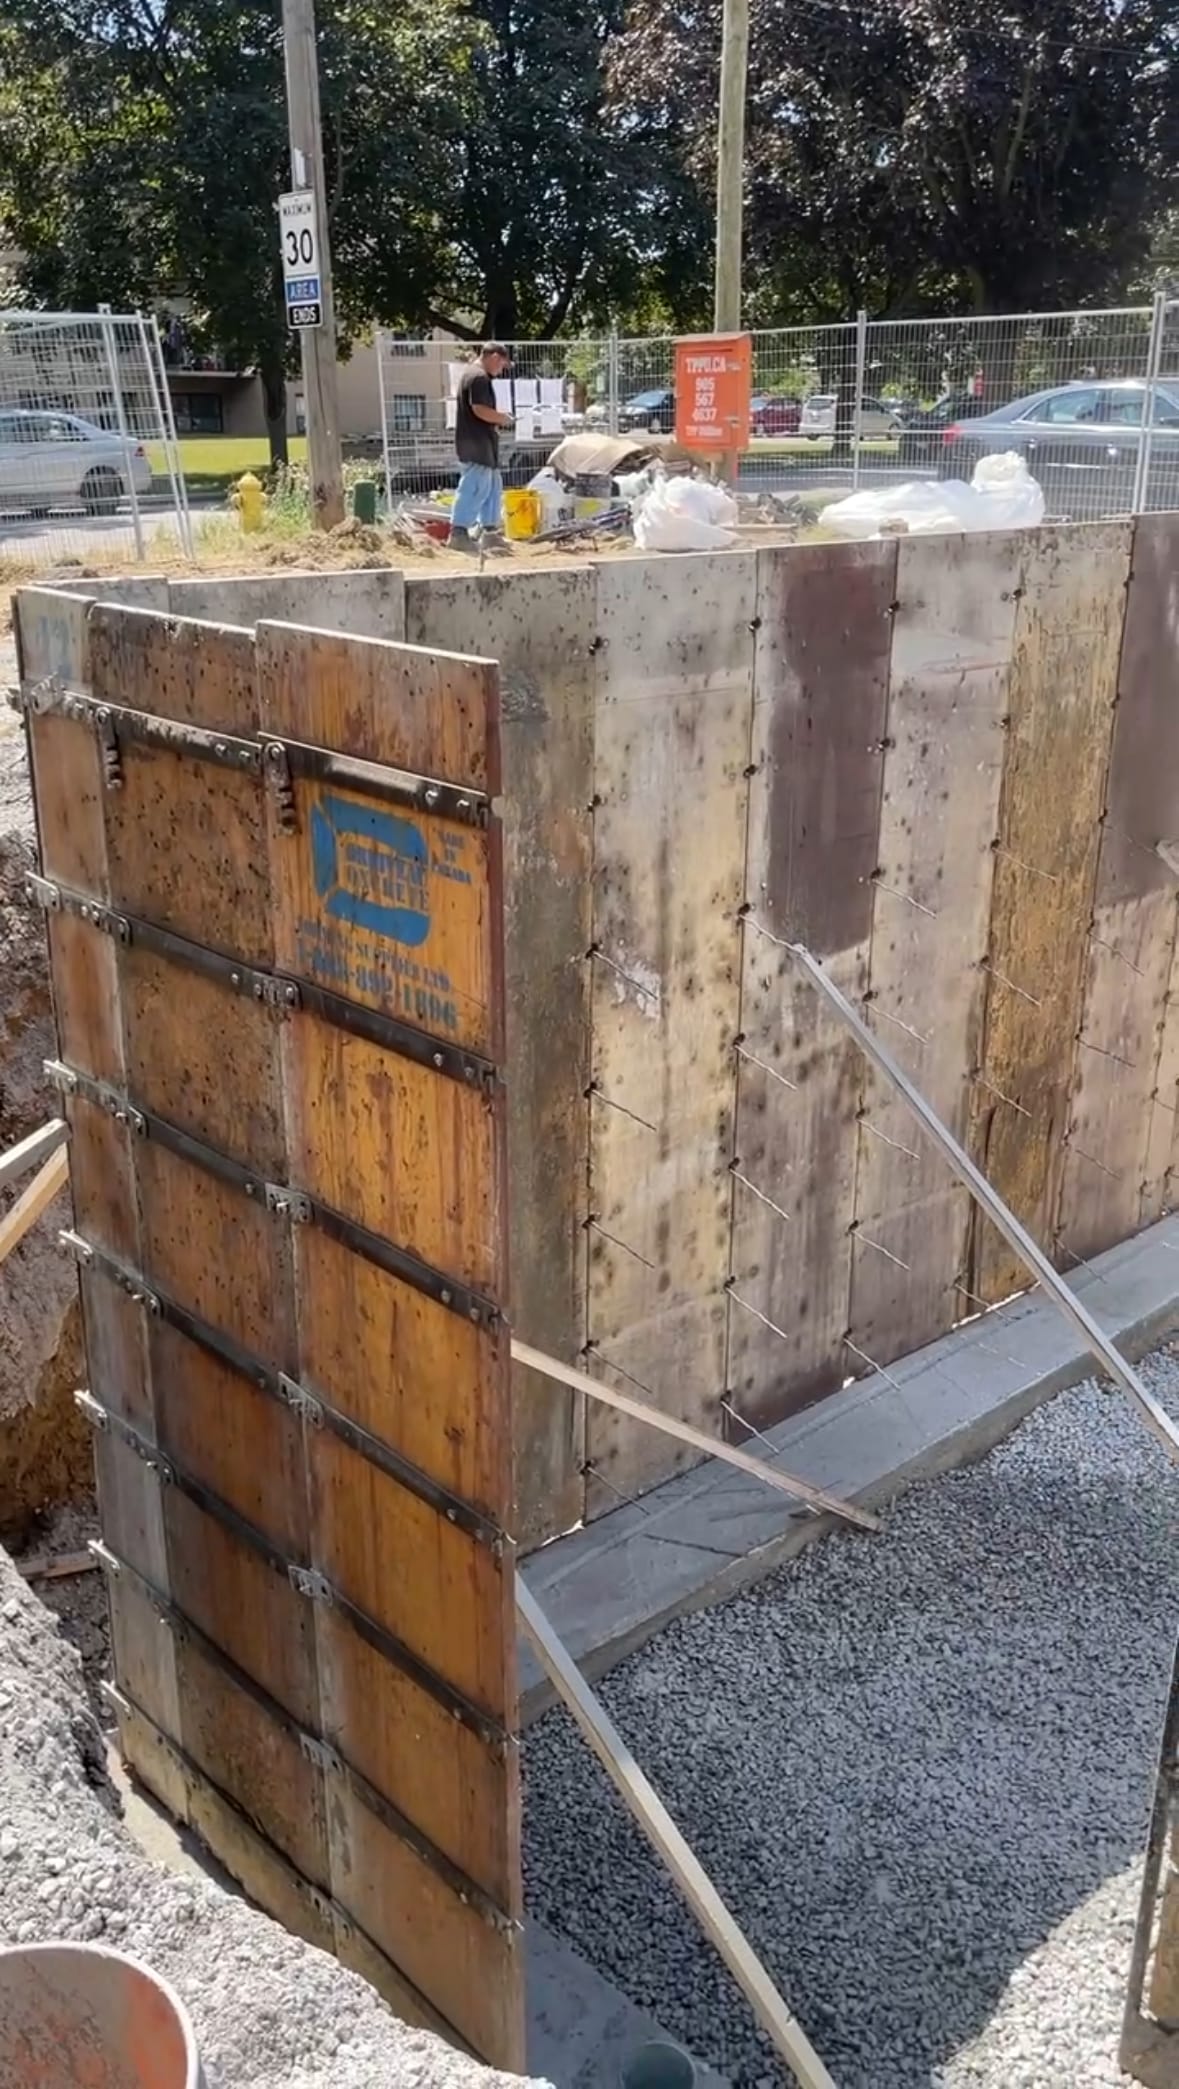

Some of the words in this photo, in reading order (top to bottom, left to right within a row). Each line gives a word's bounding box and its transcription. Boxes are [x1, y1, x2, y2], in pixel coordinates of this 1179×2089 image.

[283, 203, 312, 217] MAXIMUM
[286, 228, 313, 266] 30
[290, 281, 317, 299] AREA
[292, 306, 317, 325] ENDS
[695, 377, 715, 391] 905
[695, 392, 715, 407] 567
